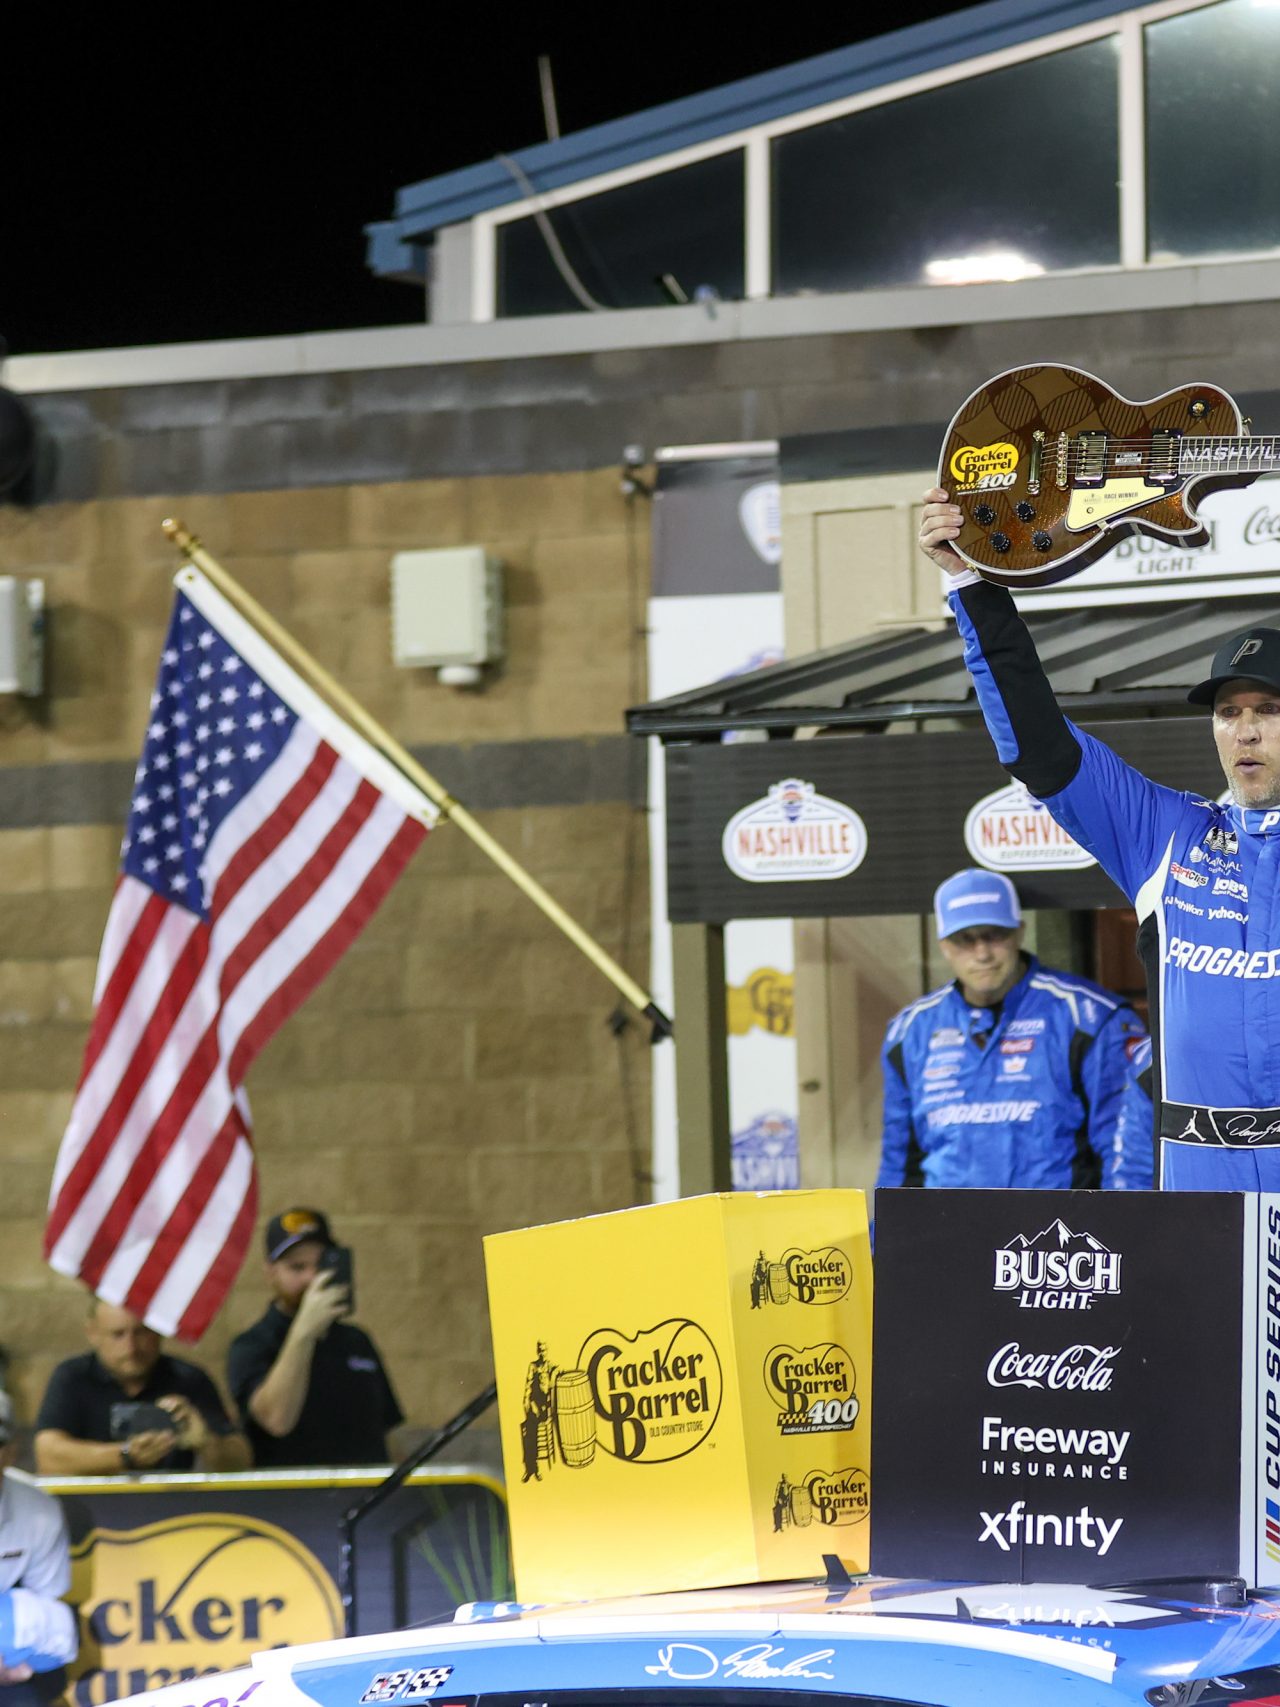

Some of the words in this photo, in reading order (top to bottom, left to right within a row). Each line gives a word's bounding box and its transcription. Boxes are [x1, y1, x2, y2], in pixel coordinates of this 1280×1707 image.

[955, 450, 1012, 473] Cracker
[964, 459, 1012, 483] Barrel
[977, 472, 1018, 489] 400
[1136, 556, 1195, 574] LIGHT
[1259, 811, 1280, 832] P
[738, 823, 852, 857] NASHVILLE
[785, 1254, 844, 1287] Cracker
[993, 1248, 1121, 1294] BUSCH
[796, 1271, 846, 1304] Barrel
[1018, 1290, 1092, 1311] LIGHT
[589, 1345, 703, 1420] Cracker
[770, 1353, 845, 1394] Cracker
[985, 1341, 1122, 1392] Coca-Cola
[785, 1374, 848, 1415] Barrel
[609, 1376, 709, 1461] Barrel
[807, 1398, 859, 1425] 400
[649, 1427, 661, 1439] OLD
[661, 1424, 686, 1437] COUNTRY
[686, 1420, 704, 1433] STORE
[783, 1425, 811, 1434] NASHVILLE
[982, 1416, 1131, 1464] Freeway
[982, 1460, 1129, 1481] INSURANCE
[808, 1476, 866, 1509] Cracker
[820, 1492, 868, 1525] Barrel
[978, 1500, 1124, 1555] xfinity
